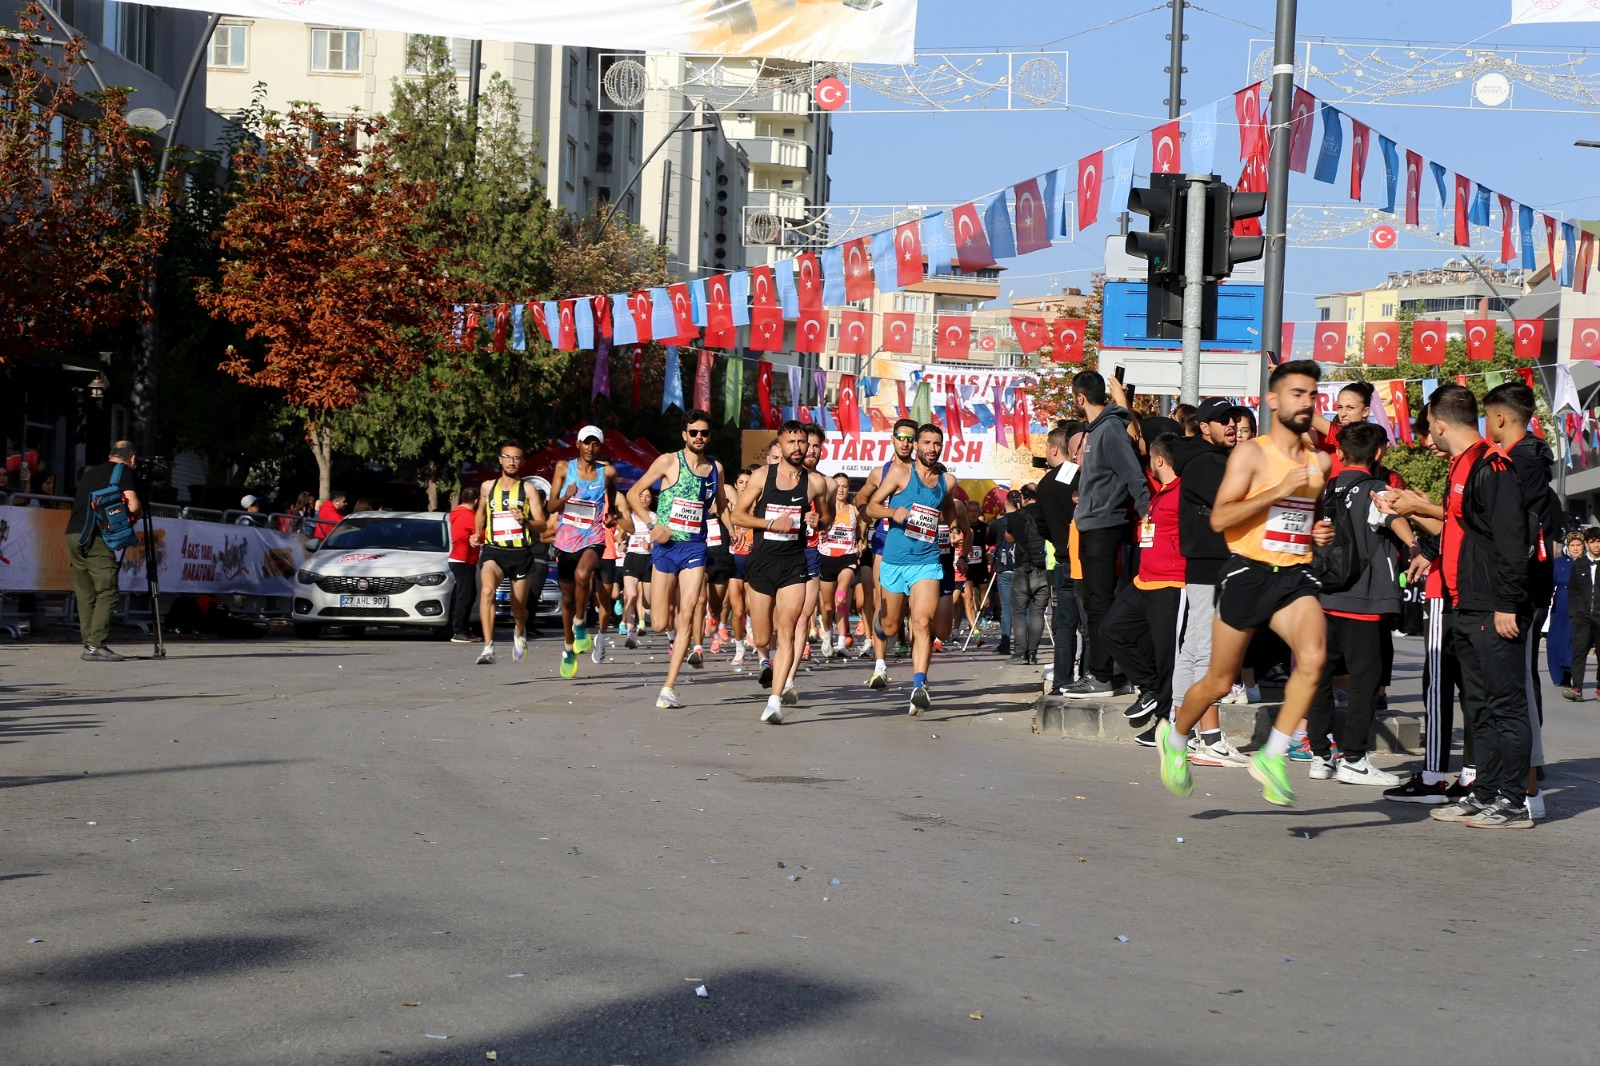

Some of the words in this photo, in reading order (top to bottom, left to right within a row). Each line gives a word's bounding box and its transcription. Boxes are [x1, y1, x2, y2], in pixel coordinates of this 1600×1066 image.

[919, 514, 934, 523] ÖMER
[181, 534, 188, 559] 4
[181, 562, 217, 582] MARATONU
[345, 596, 354, 605] 27
[356, 596, 370, 605] AHL
[372, 597, 387, 605] 907
